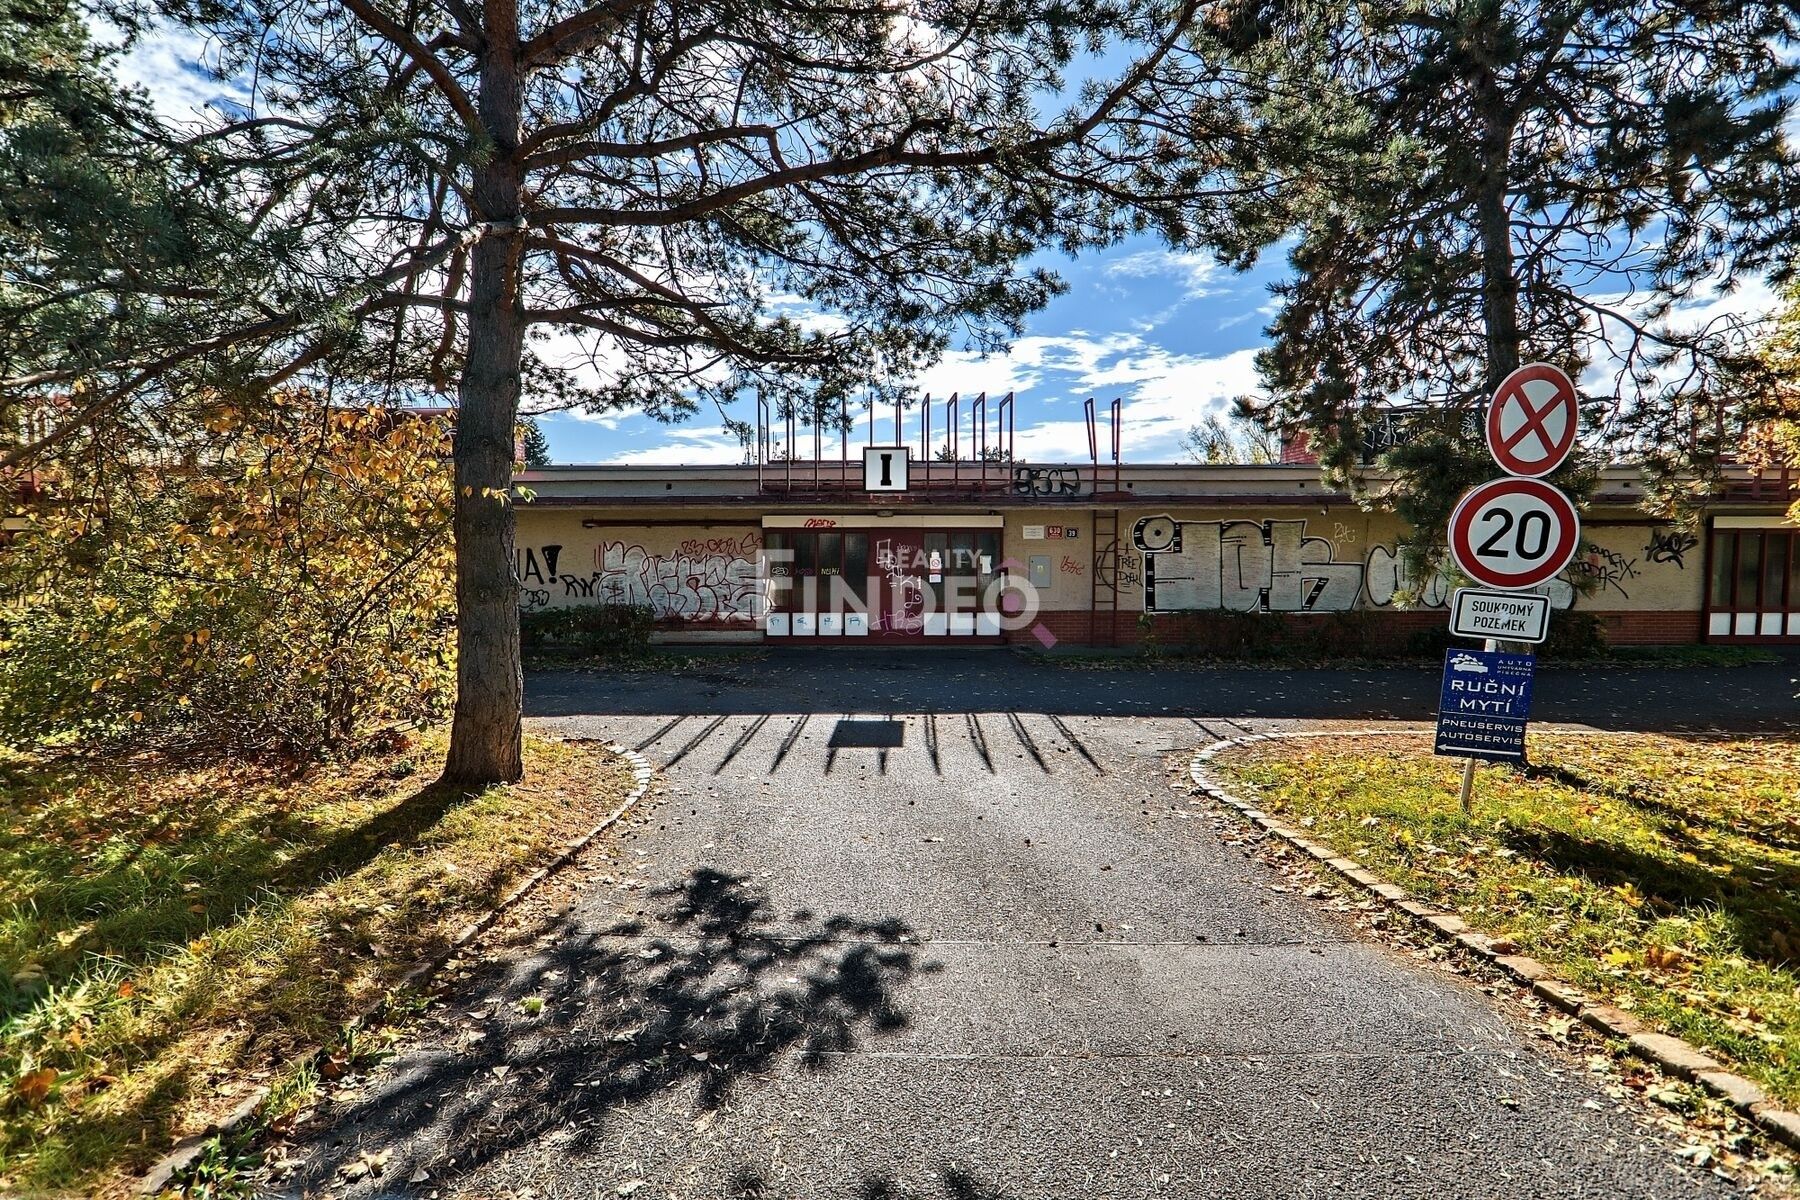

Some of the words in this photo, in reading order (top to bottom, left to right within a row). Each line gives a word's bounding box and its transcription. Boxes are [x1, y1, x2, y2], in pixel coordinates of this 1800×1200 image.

[881, 453, 892, 486] I
[1476, 507, 1551, 560] 20
[1471, 600, 1534, 617] SOUKROMÝ
[1473, 616, 1526, 632] POZEMEK
[1451, 679, 1527, 696] RUČNÍ
[1460, 698, 1512, 713] MYTÍ
[1442, 718, 1523, 733] PNEUSERVIS
[1439, 731, 1522, 745] AUTOSERVIS
